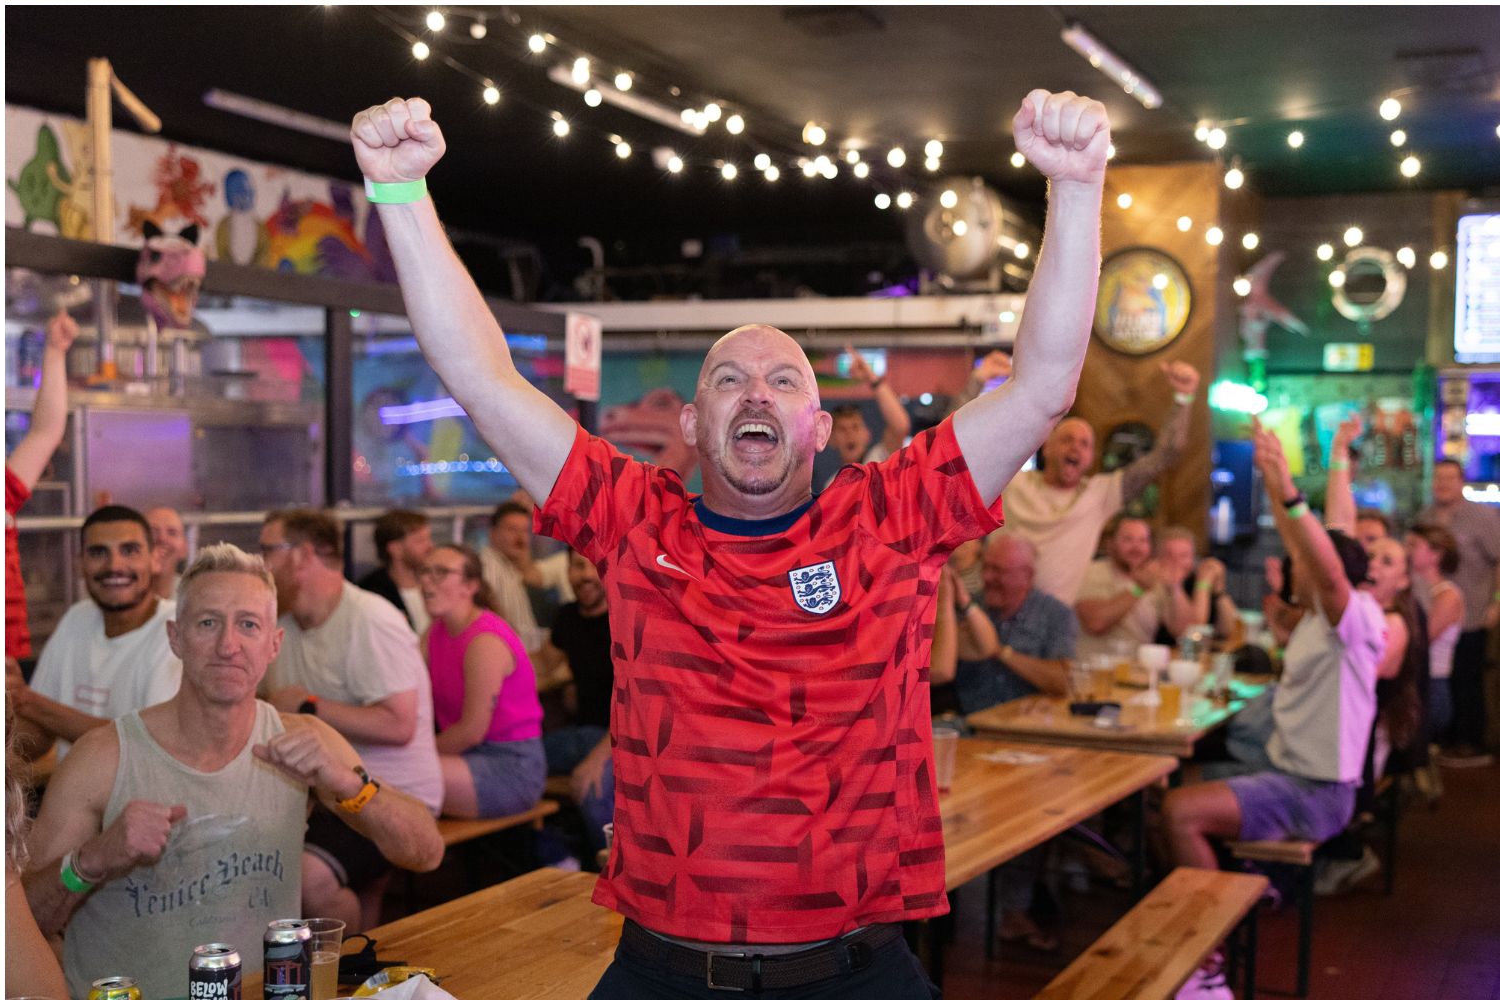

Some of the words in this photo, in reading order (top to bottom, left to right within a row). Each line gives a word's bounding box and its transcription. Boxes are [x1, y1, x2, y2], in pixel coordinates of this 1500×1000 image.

[125, 874, 210, 917] Venice
[217, 849, 284, 886] Beach
[190, 978, 228, 998] BELOW
